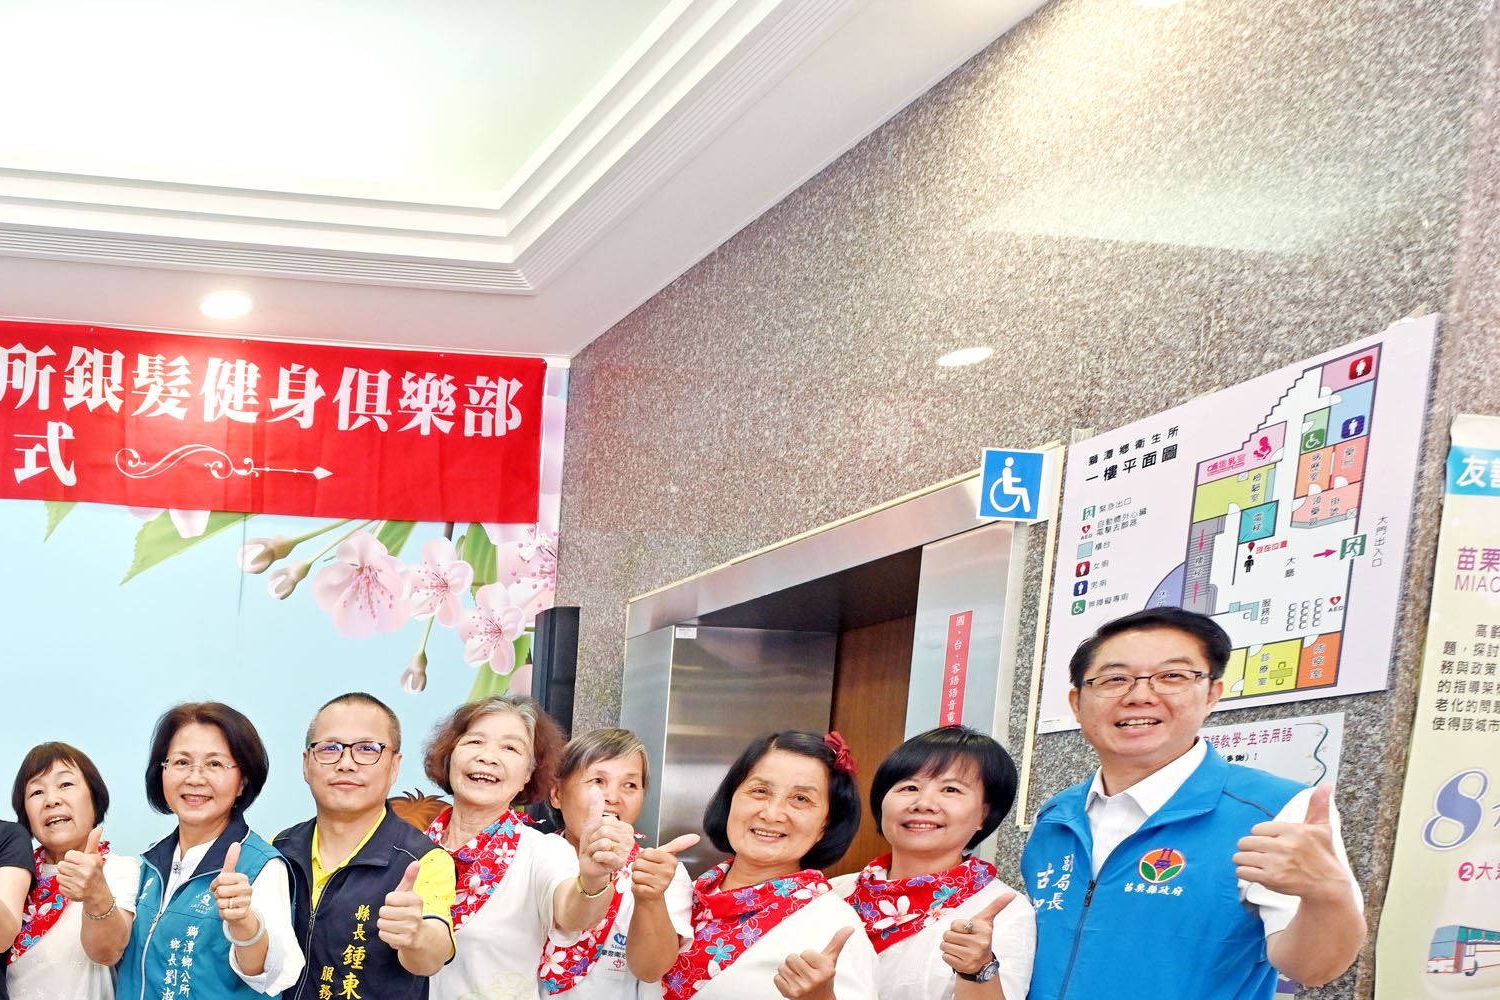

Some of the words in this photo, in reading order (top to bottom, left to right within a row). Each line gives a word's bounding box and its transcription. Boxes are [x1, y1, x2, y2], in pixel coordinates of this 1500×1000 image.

[1085, 443, 1178, 481] 一樓平面圖
[1099, 497, 1132, 513] 緊急出口
[1372, 516, 1388, 567] 大門出入口
[1437, 679, 1500, 695] 的指導架
[1046, 853, 1075, 911] 副局長
[1476, 861, 1500, 881] 大
[1123, 882, 1185, 897] 苗栗縣政府
[180, 924, 199, 998] 獅潭鄉公所
